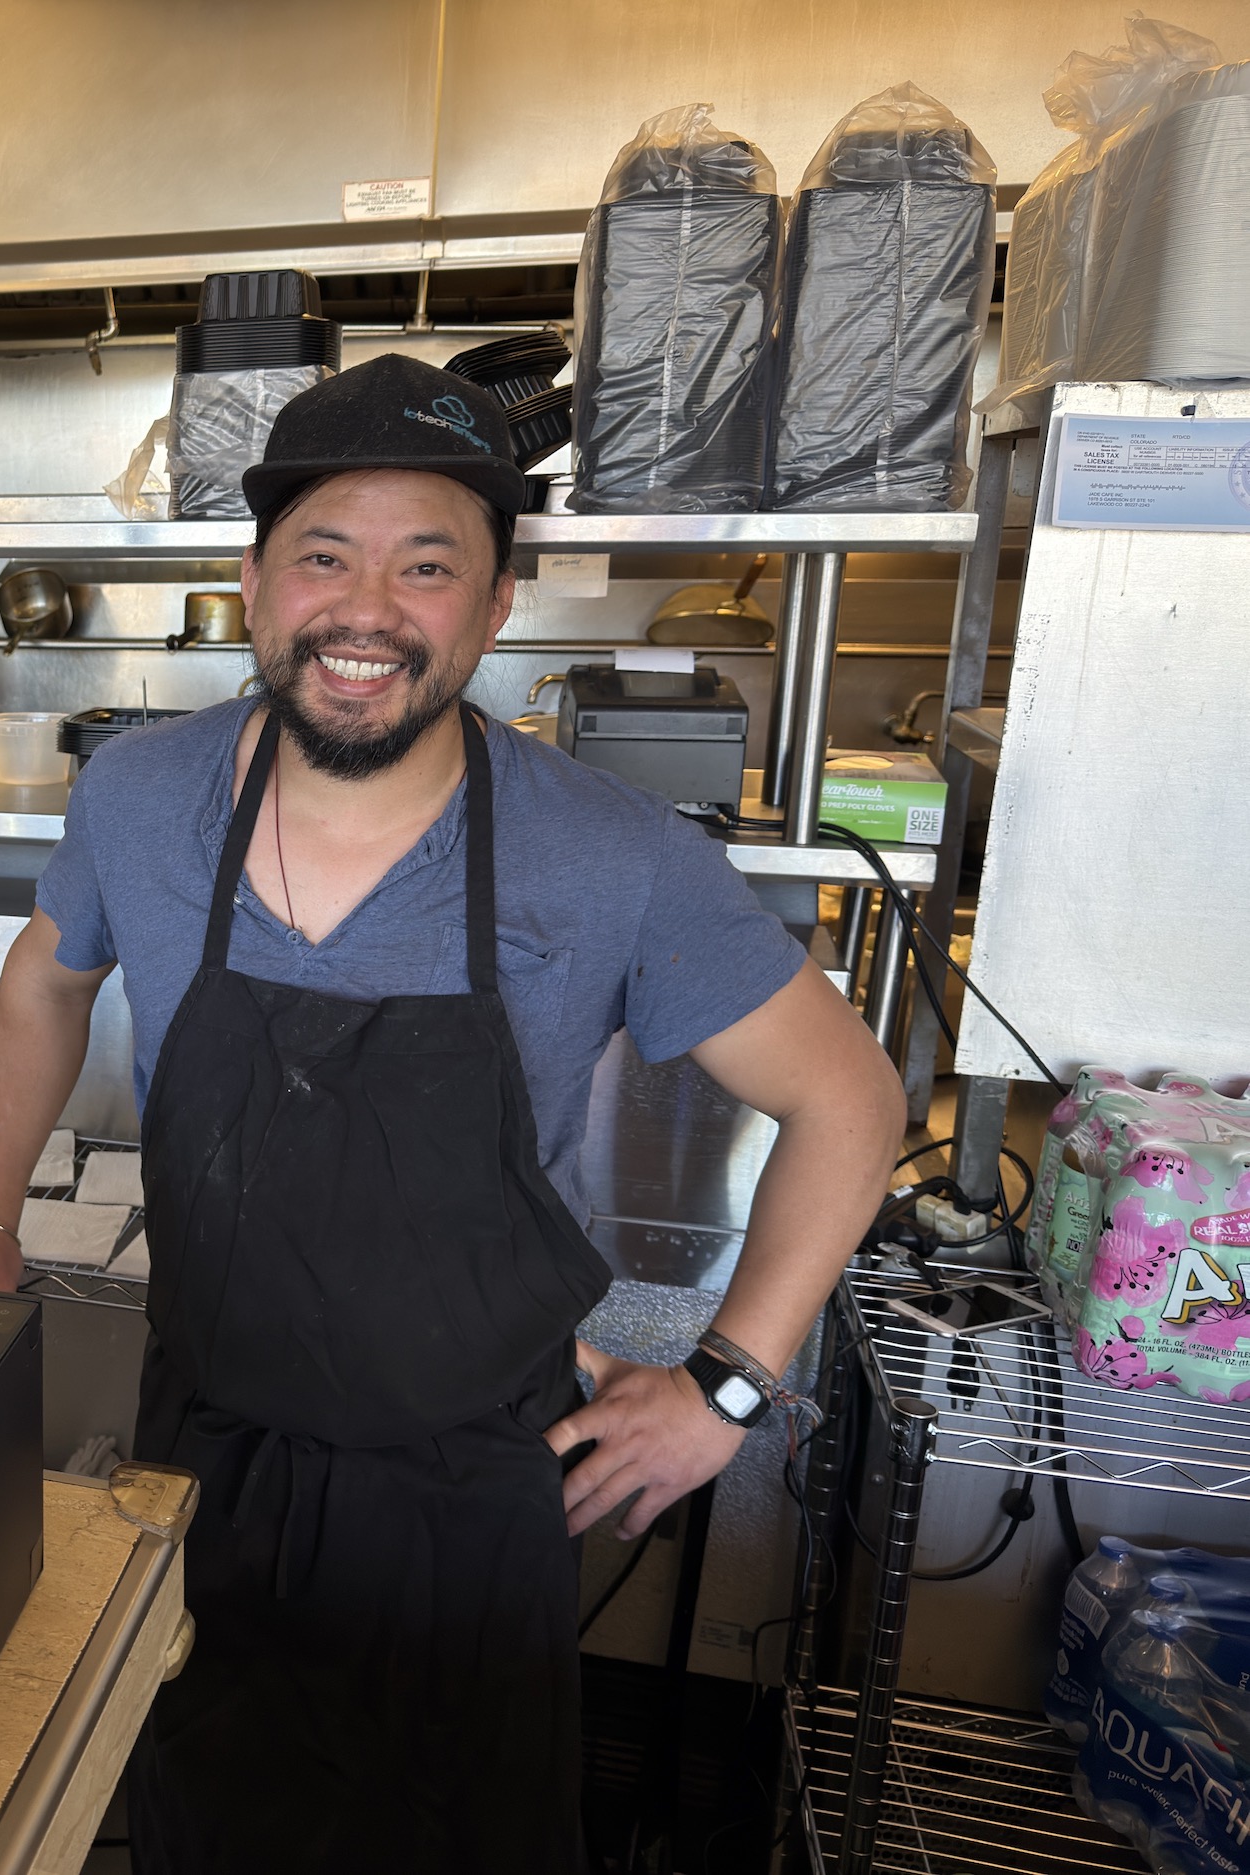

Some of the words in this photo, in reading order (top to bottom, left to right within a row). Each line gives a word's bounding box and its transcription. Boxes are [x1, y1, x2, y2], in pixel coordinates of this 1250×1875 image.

[370, 182, 404, 191] CAUTION
[822, 783, 884, 797] earTouch
[911, 809, 939, 821] ONE
[910, 821, 939, 831] SIZE
[1193, 1226, 1238, 1236] REAL
[1161, 1338, 1172, 1346] FL.
[1174, 1340, 1186, 1348] OZ.
[1189, 1343, 1219, 1355] (473ML)
[1136, 1344, 1155, 1352] TOTAL
[1157, 1346, 1187, 1356] VOLUME
[1194, 1352, 1209, 1360] 384
[1211, 1355, 1223, 1364] FL.
[1225, 1358, 1237, 1366] OZ.
[1107, 1769, 1138, 1787] pure
[1141, 1784, 1169, 1811] water,
[1168, 1806, 1209, 1851] perfect
[1207, 1845, 1241, 1875] taste
